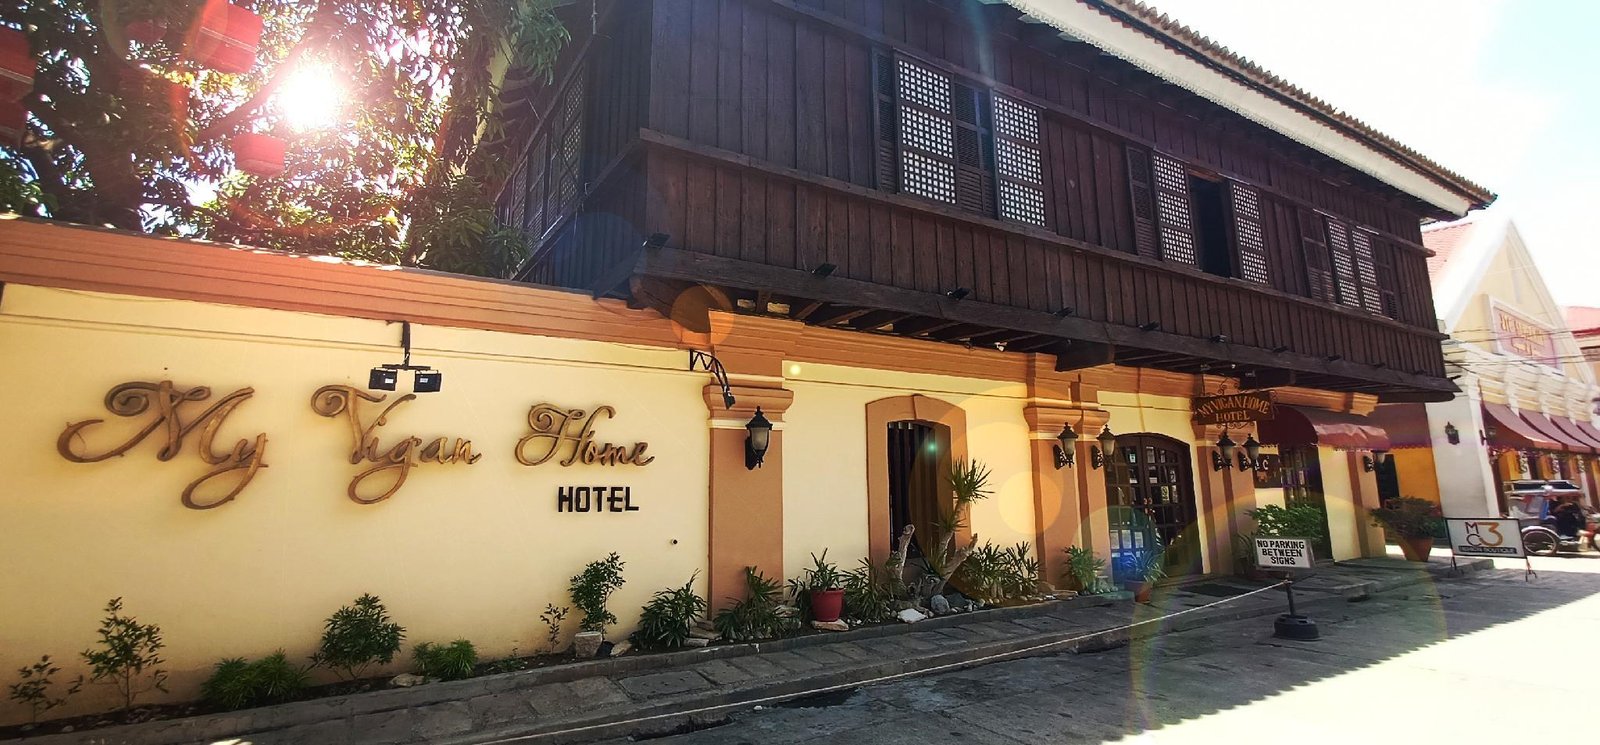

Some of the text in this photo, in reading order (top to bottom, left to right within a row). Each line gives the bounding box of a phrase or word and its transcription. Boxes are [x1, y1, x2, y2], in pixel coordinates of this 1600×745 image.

[1198, 402, 1213, 416] MY
[1243, 396, 1269, 414] HOME
[1216, 410, 1250, 422] HOTEL
[57, 380, 654, 510] My Vigan Home
[558, 487, 638, 512] HOTEL
[1257, 540, 1305, 549] NO PARKING
[1262, 549, 1302, 557] BETWEEN
[1271, 557, 1296, 565] SIGNS
